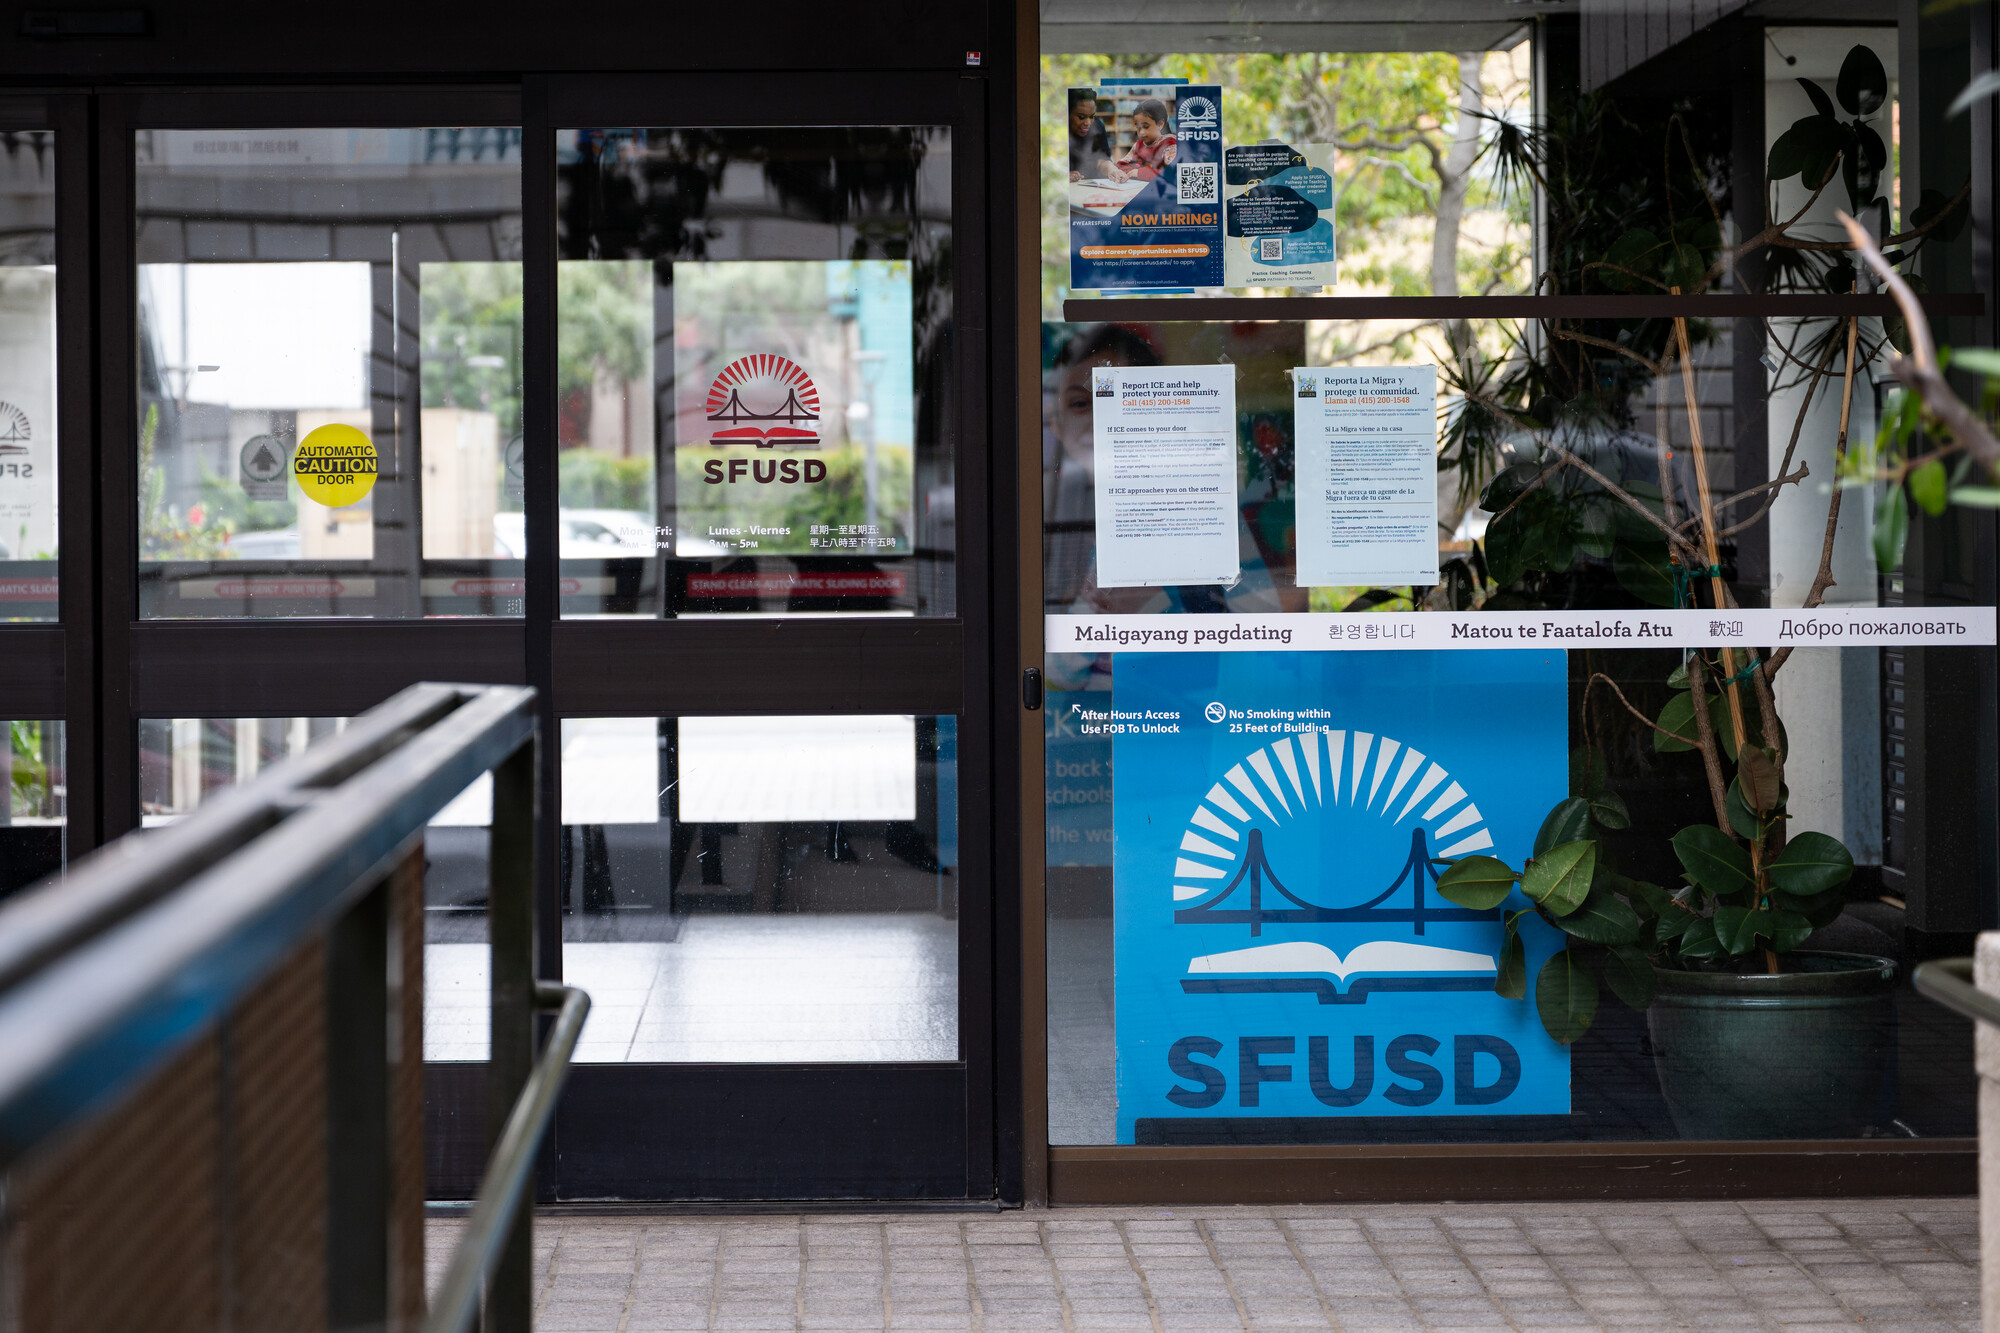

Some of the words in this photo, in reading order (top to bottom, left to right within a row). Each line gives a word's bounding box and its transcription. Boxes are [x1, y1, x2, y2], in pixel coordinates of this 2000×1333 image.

[1178, 131, 1219, 141] SFUSD
[1122, 214, 1158, 226] NOW
[1162, 213, 1218, 225] HIRING!
[1183, 381, 1200, 389] help
[1325, 377, 1358, 386] Reporta
[1372, 377, 1396, 385] Migra
[1122, 390, 1151, 398] protect
[1173, 389, 1220, 397] community.
[1325, 389, 1357, 397] protege
[299, 446, 373, 456] AUTOMATIC
[295, 459, 376, 472] CAUTION
[704, 458, 827, 484] SFUSD
[318, 475, 354, 484] DOOR
[655, 526, 672, 535] Fri:
[709, 526, 741, 535] Lunes
[750, 525, 791, 535] Viernes
[740, 539, 758, 548] 5PM
[809, 538, 896, 548] 早上八時至下午五時
[826, 579, 867, 589] SLIDING
[1075, 624, 1190, 644] Maligayang
[1194, 623, 1292, 644] pagdating
[1328, 624, 1416, 640] 환영합니다
[1451, 623, 1513, 639] Matou
[1517, 624, 1537, 638] te
[1542, 621, 1632, 638] Faatalofa
[1637, 622, 1673, 638] Atu
[1708, 620, 1743, 637] 歡迎
[1779, 619, 1844, 640] Добро
[1849, 620, 1966, 638] пожаловать
[1081, 709, 1108, 720] After
[1111, 710, 1143, 720] Hours
[1145, 710, 1180, 720] Access
[1229, 709, 1244, 719] No
[1247, 709, 1295, 721] Smoking
[1297, 709, 1331, 719] within
[1081, 724, 1101, 734] Use
[1103, 724, 1126, 734] FOB
[1127, 724, 1140, 734] To
[1142, 723, 1180, 733] Unlock
[1230, 723, 1243, 733] 25
[1245, 723, 1268, 733] Feet
[1270, 722, 1282, 733] of
[1284, 722, 1329, 735] Building
[1056, 759, 1102, 778] back
[1049, 825, 1079, 842] the
[1165, 1034, 1522, 1108] SFUSD
